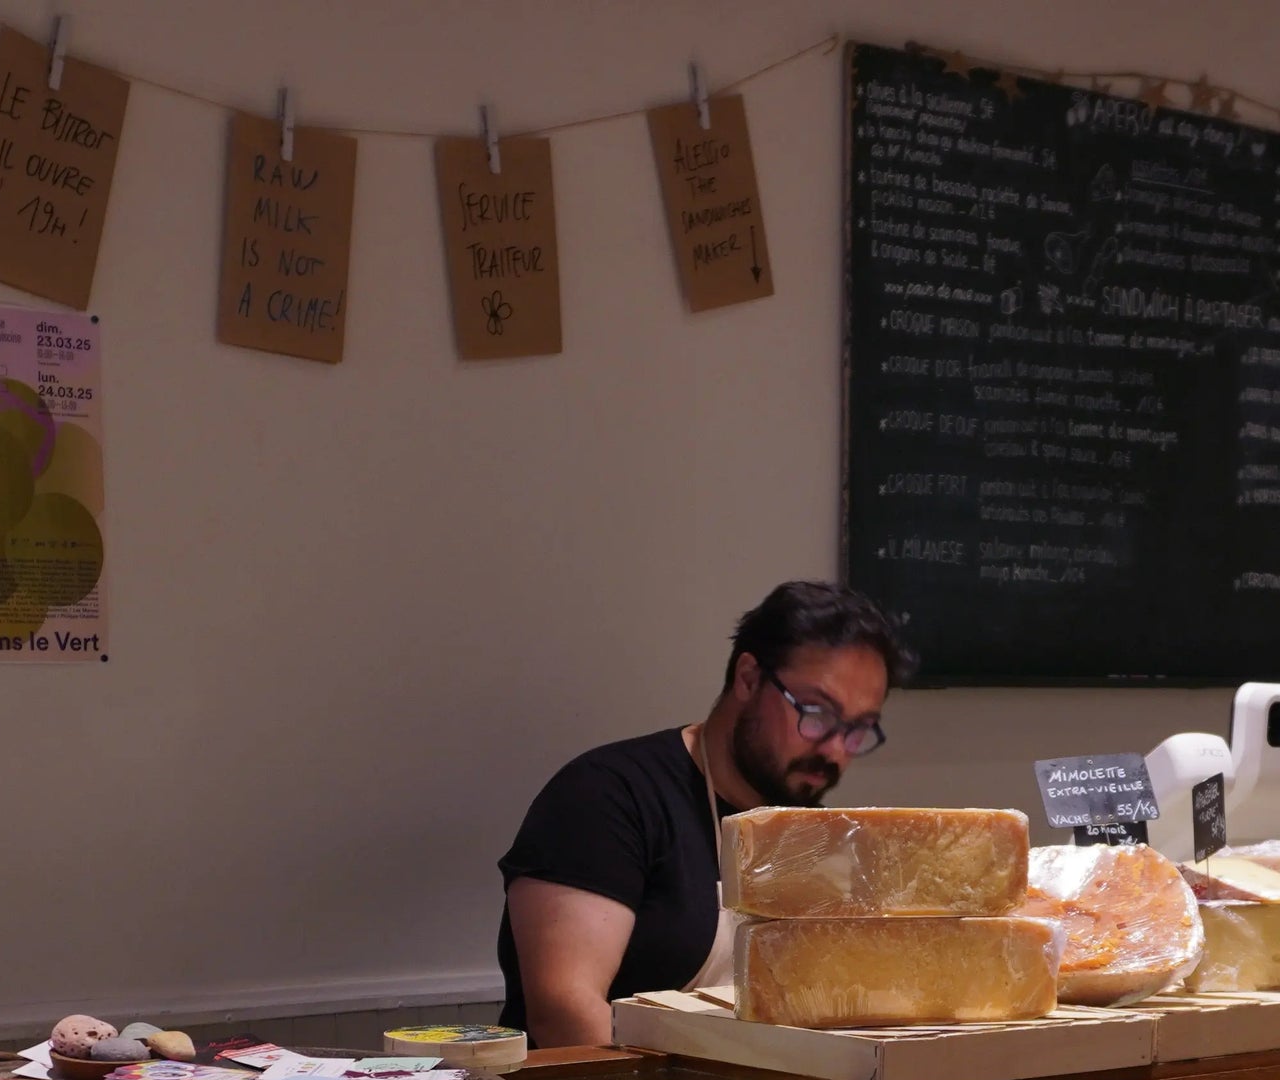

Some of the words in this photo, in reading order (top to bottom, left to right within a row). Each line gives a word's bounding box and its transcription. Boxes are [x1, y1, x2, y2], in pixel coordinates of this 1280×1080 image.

[26, 154, 95, 196] OUVRE
[252, 154, 318, 191] RAW
[252, 197, 320, 235] MILK
[457, 182, 536, 232] SERVICE
[241, 237, 259, 268] IS
[278, 248, 325, 277] NOT
[465, 241, 545, 281] TRAITEUR
[238, 282, 252, 317] A
[36, 322, 62, 334] dim.
[36, 335, 91, 351] 23.03.25
[37, 370, 59, 384] lun.
[37, 385, 93, 401] 24.03.25
[29, 631, 49, 651] le
[54, 631, 100, 651] Vert
[1049, 767, 1127, 783] MIMOLETTE
[1047, 781, 1144, 798] EXTRA-VIEILLE
[1050, 814, 1090, 825] VACHE
